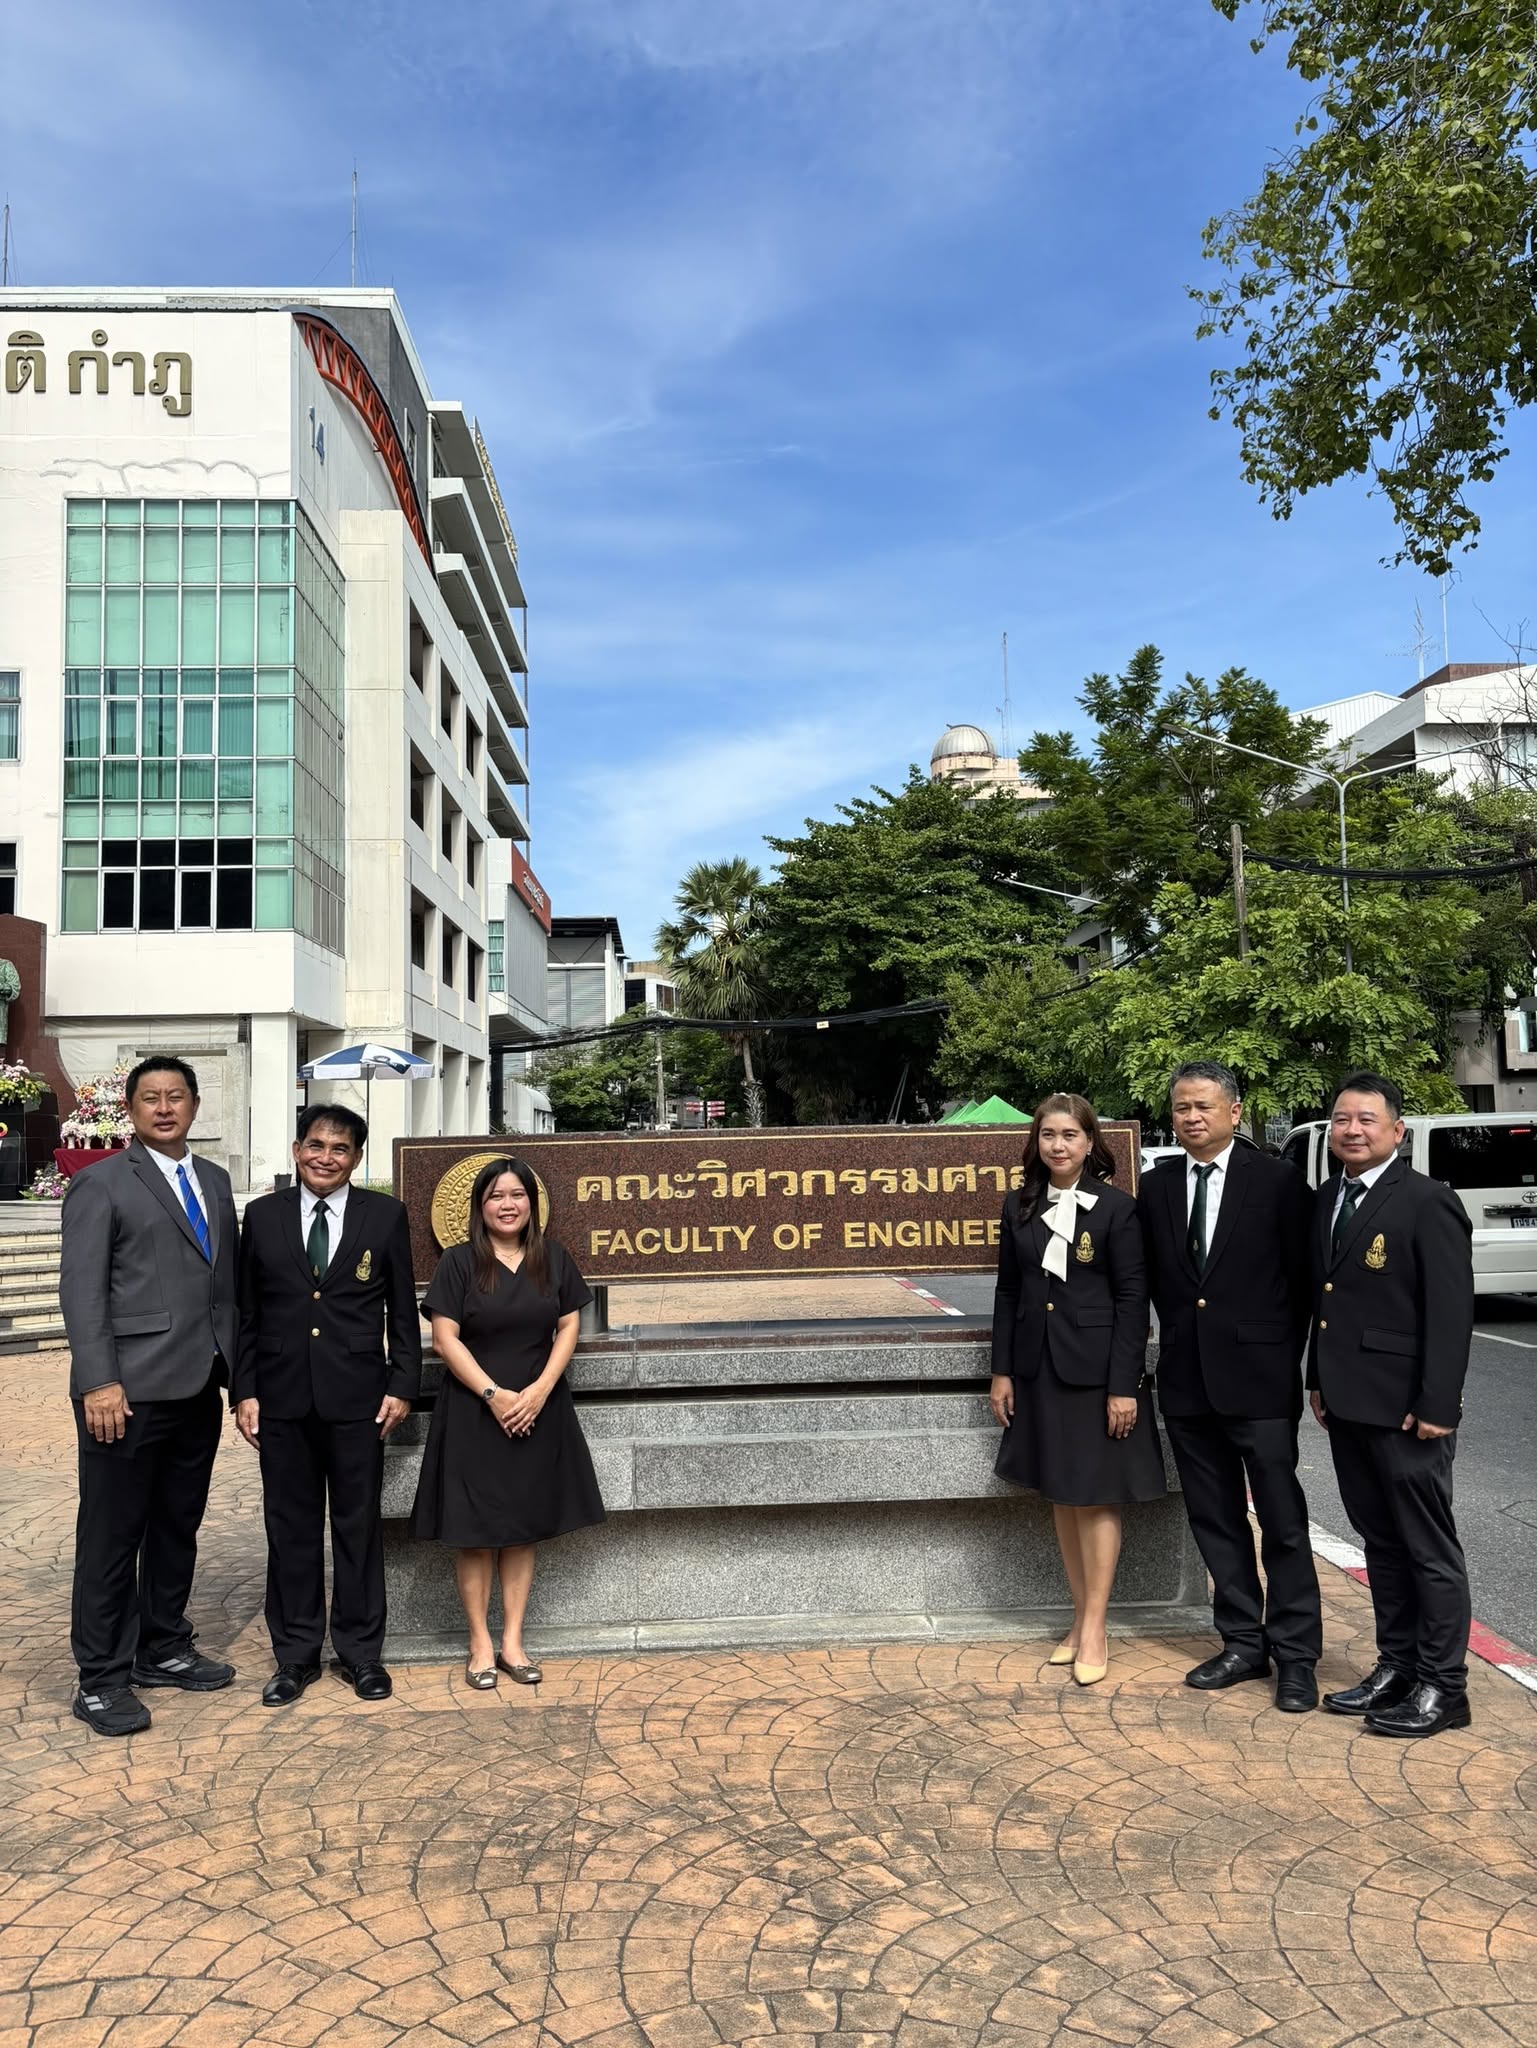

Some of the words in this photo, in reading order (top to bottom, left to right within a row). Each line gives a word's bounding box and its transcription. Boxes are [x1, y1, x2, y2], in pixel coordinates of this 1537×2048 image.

[67, 328, 193, 417] กำภู
[590, 1224, 756, 1256] FACULTY
[772, 1223, 823, 1250] OF
